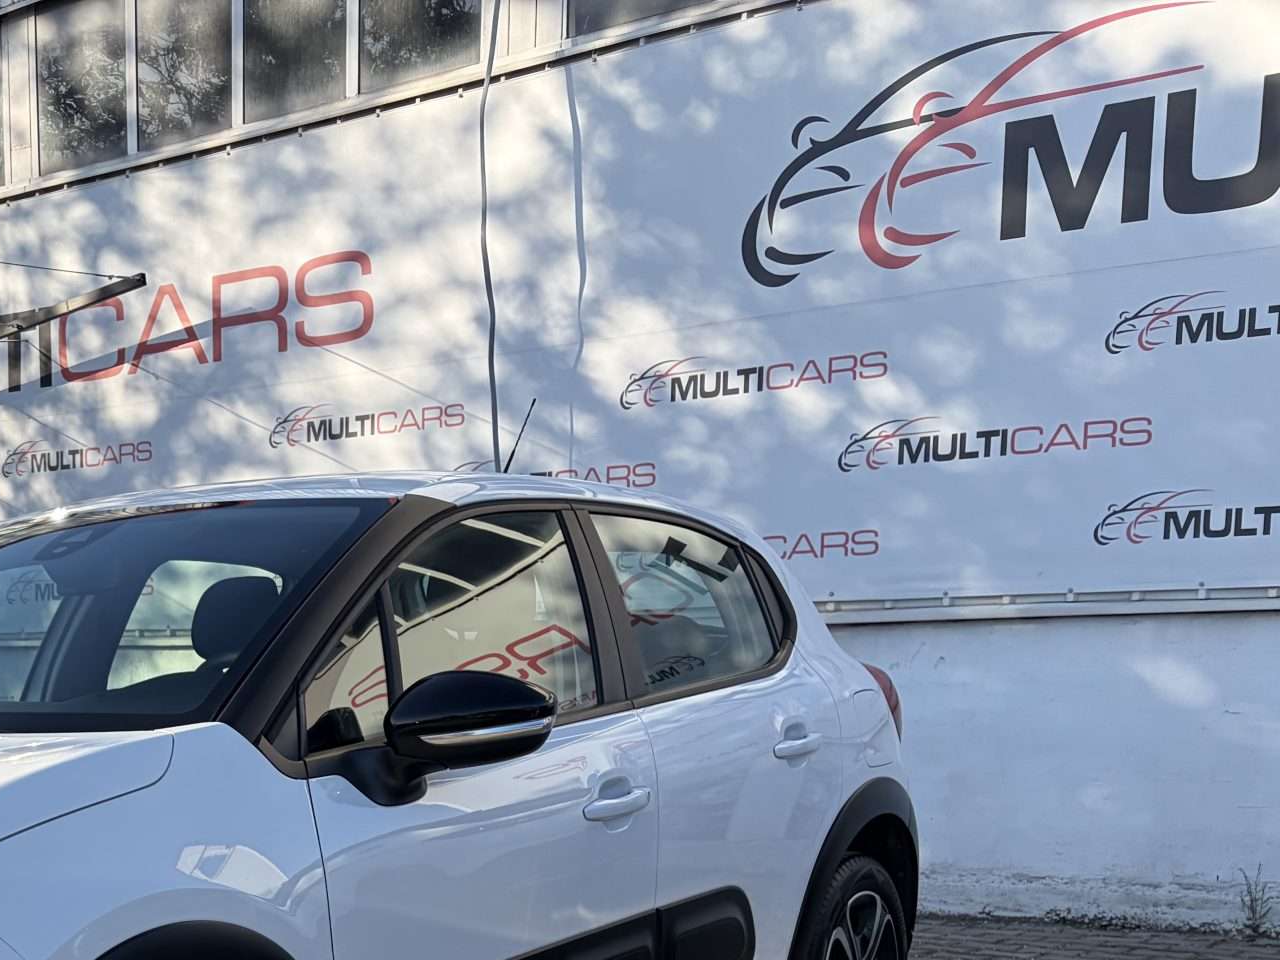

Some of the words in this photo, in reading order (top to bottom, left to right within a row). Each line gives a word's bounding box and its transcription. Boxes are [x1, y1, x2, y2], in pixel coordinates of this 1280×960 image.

[670, 351, 888, 402] MULTICARS
[307, 403, 465, 443] MULTICARS
[898, 417, 1152, 465] MULTICARS
[30, 440, 152, 473] MULTICARS
[1163, 506, 1280, 540] MULT
